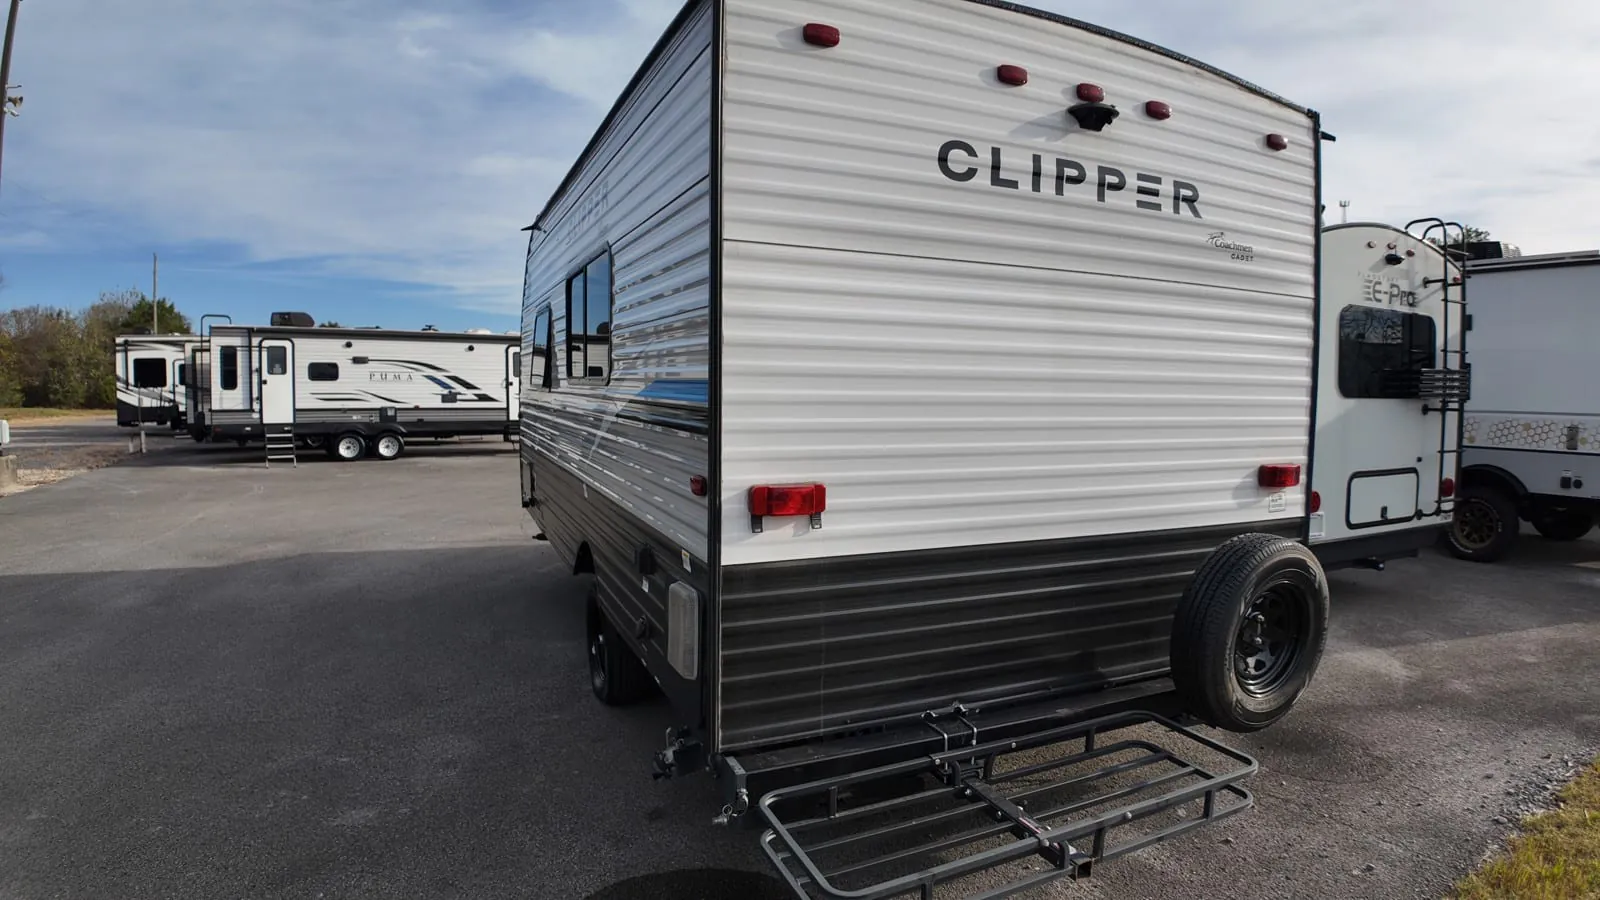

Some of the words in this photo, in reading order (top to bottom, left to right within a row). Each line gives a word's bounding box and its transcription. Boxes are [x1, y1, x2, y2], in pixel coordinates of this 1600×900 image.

[937, 139, 1203, 219] CLIPPER
[1214, 238, 1253, 253] Coachmen
[1372, 280, 1417, 308] E-Pro
[368, 372, 414, 382] PUMA
